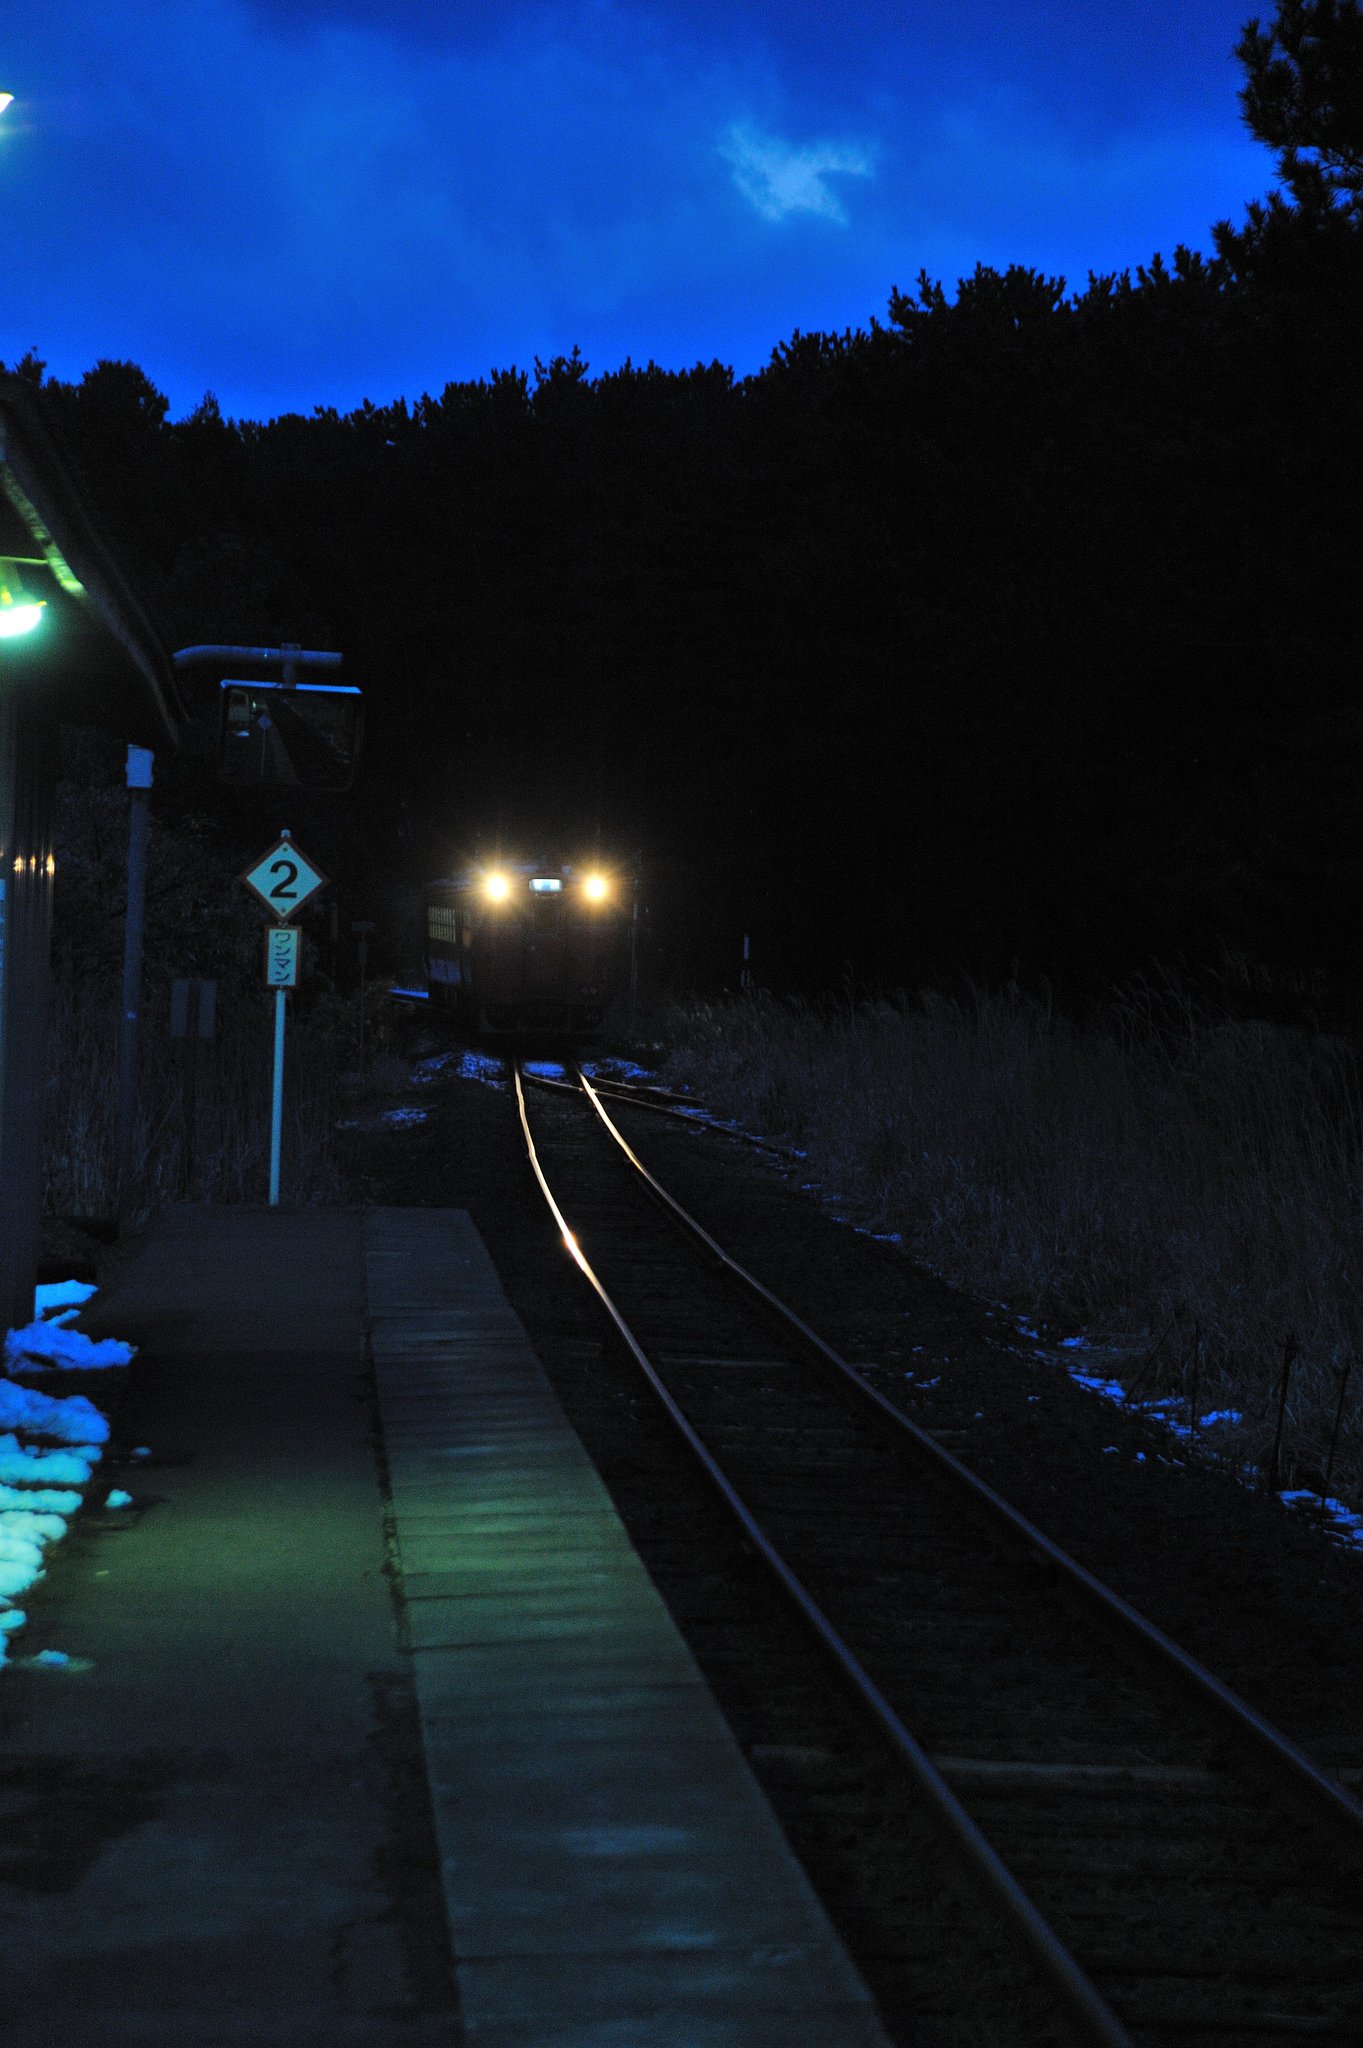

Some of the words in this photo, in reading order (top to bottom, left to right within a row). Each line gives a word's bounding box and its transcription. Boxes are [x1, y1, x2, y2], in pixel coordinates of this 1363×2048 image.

[270, 860, 298, 898] 2
[274, 931, 291, 981] ワンマン
